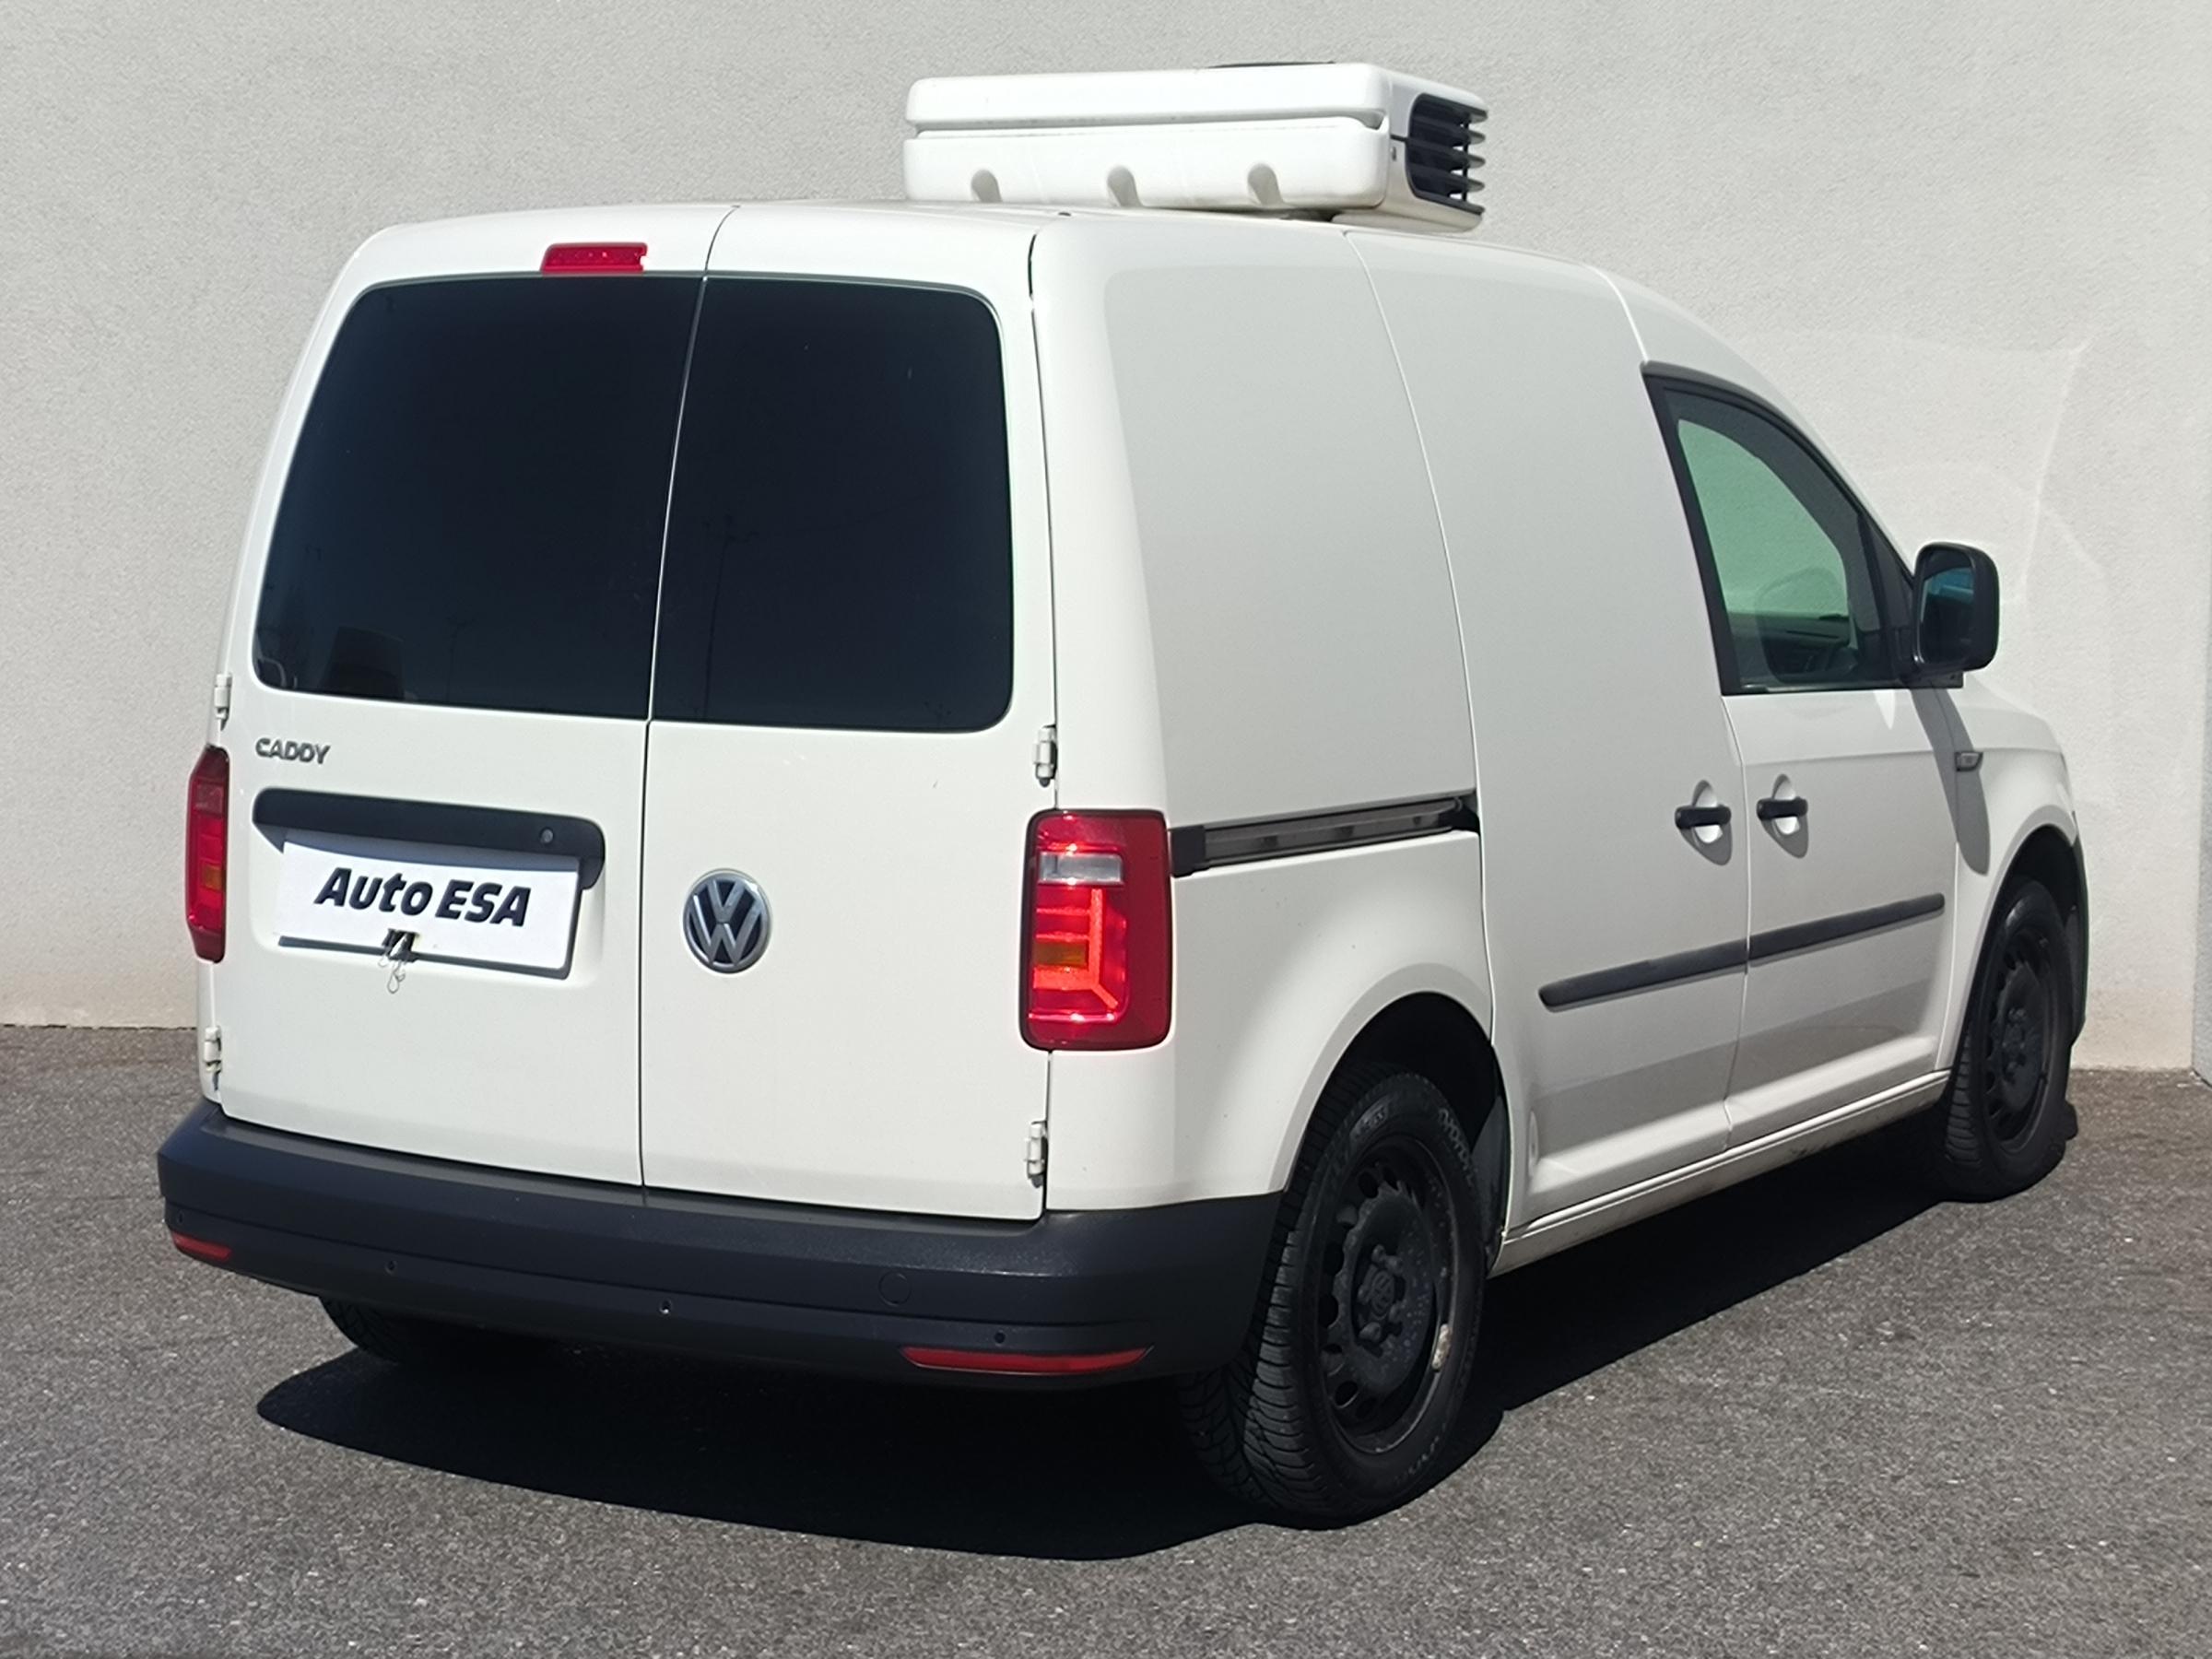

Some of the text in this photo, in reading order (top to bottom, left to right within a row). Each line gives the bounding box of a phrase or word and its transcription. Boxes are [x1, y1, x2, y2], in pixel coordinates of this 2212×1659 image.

[255, 736, 331, 765] CADDY
[313, 866, 532, 927] Auto ESA
[684, 871, 769, 971] VW
